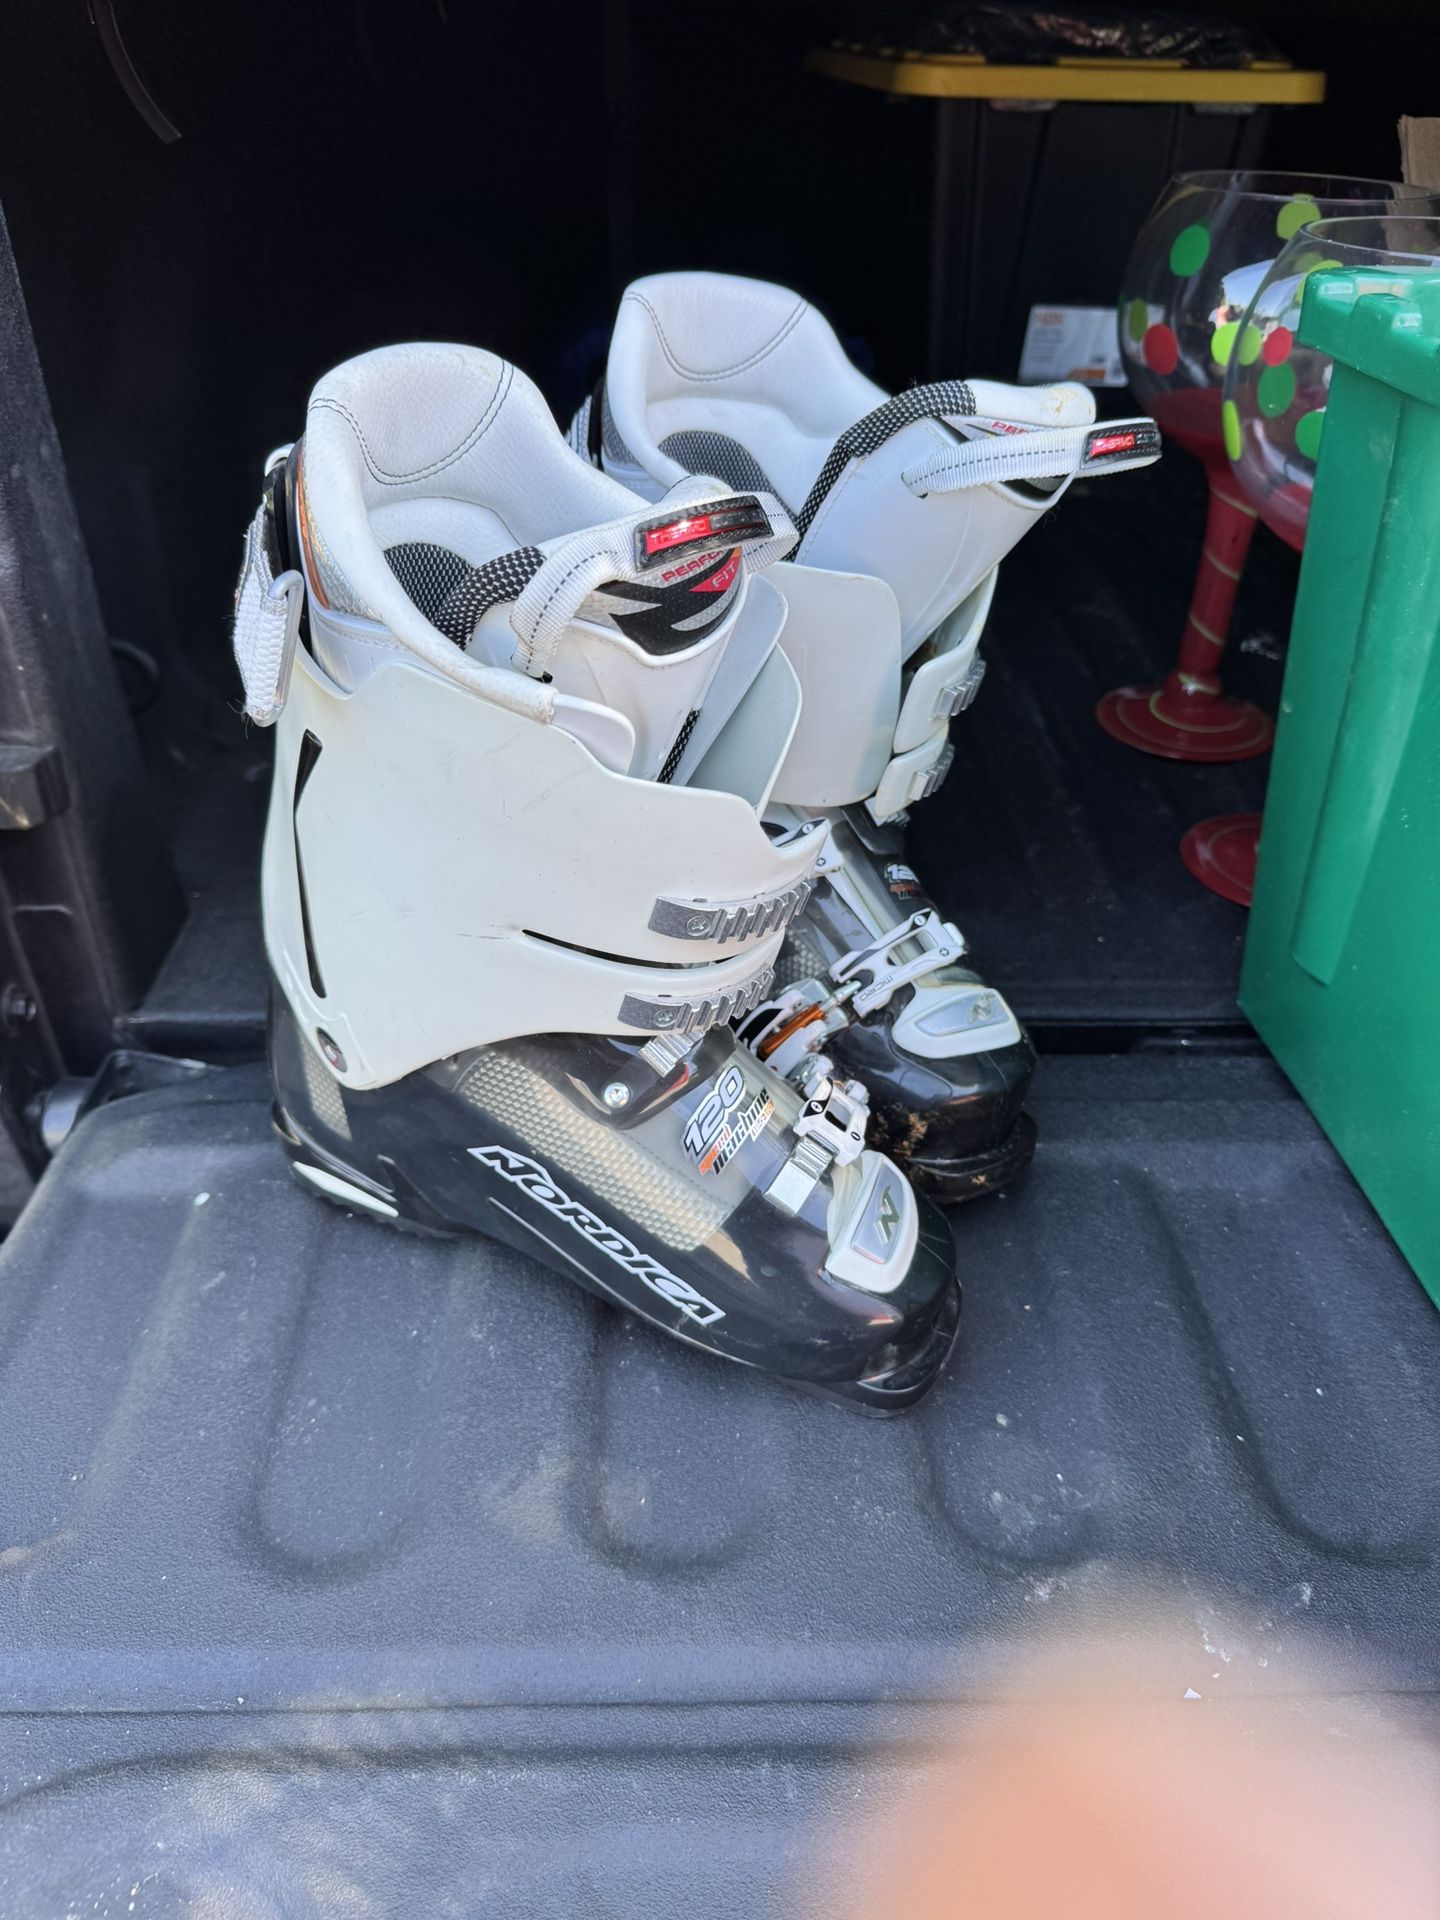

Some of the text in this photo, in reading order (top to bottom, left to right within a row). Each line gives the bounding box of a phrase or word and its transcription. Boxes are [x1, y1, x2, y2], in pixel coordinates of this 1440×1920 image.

[711, 560, 735, 589] FIT
[684, 1065, 745, 1157] 120
[467, 1145, 726, 1326] NORDICA
